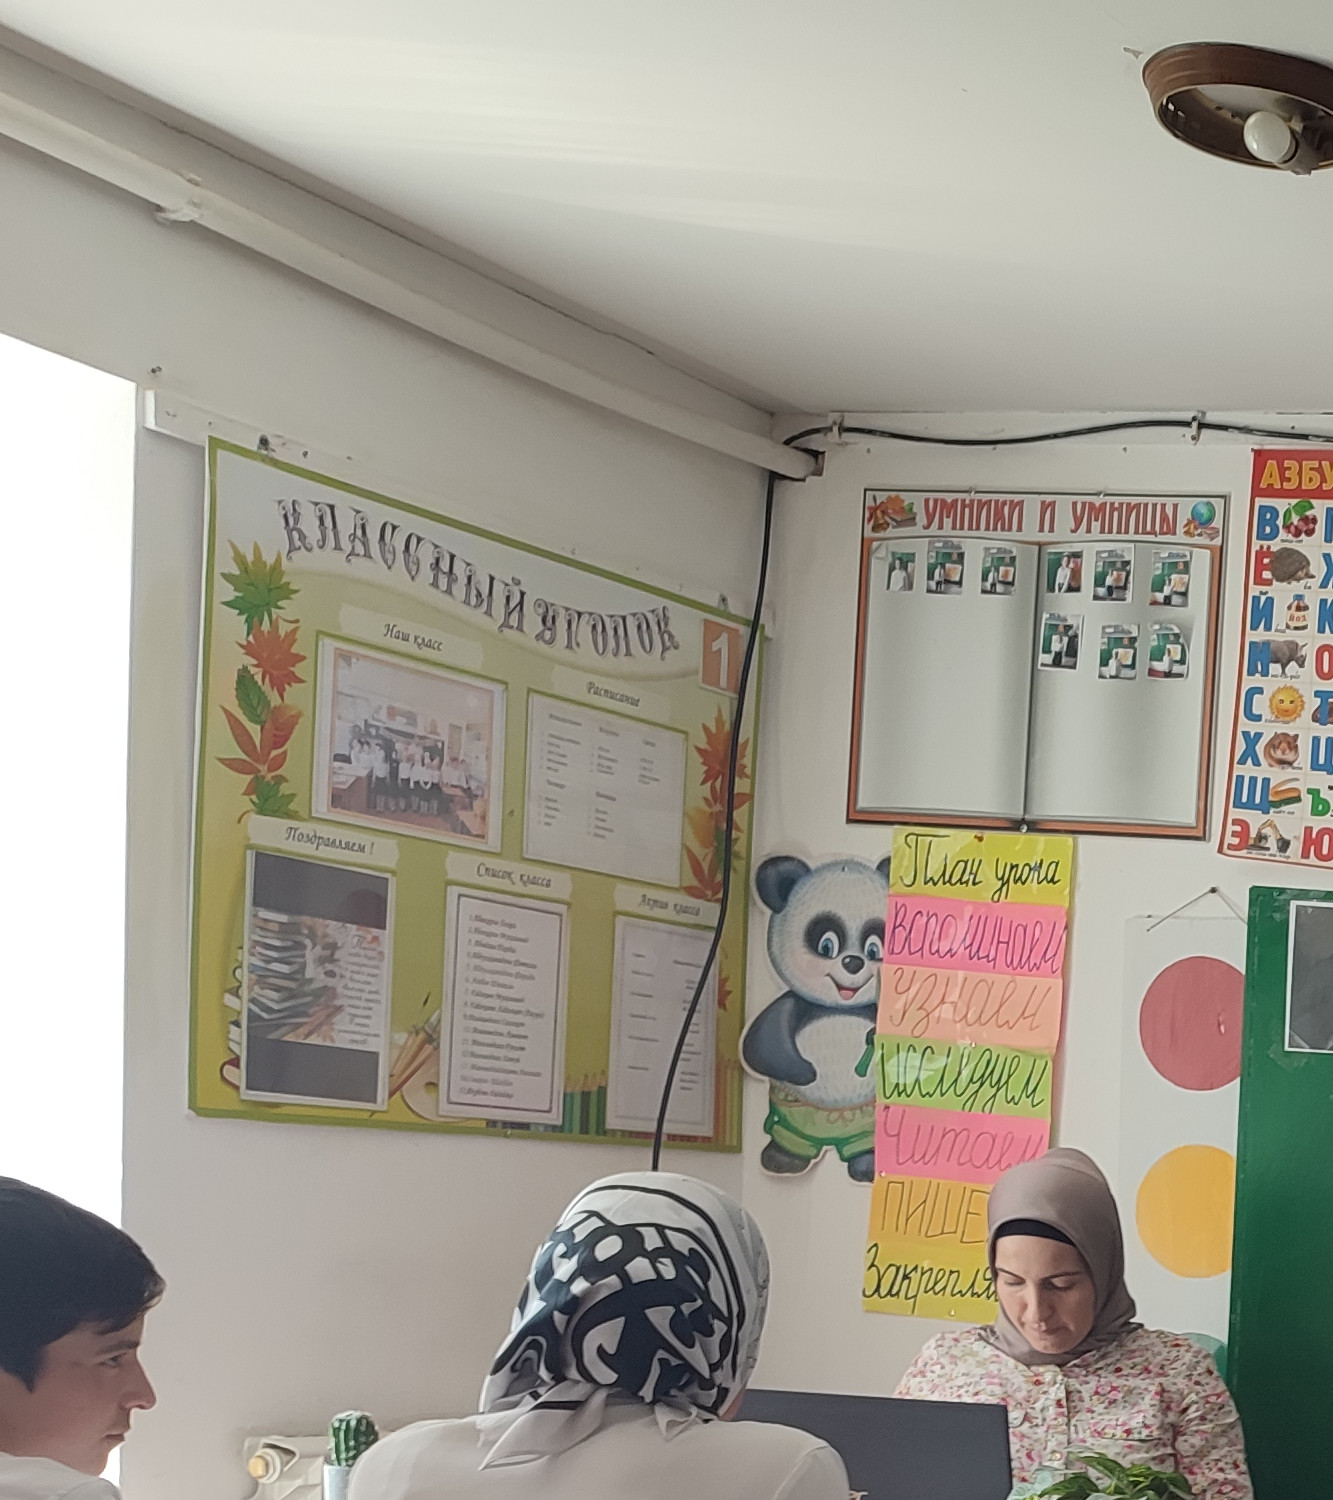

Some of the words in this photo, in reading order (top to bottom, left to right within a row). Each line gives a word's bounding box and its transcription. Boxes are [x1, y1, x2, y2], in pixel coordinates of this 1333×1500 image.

[922, 497, 1025, 533] УМНИКИ
[1038, 499, 1057, 534] И
[1069, 500, 1180, 538] УМНИЦЫ
[1256, 505, 1279, 541] В
[277, 498, 527, 634] КЛАССНЫЙ
[533, 597, 680, 661] УГОЛОК
[1251, 590, 1275, 632] Й
[383, 623, 411, 643] Наш
[413, 634, 444, 652] класс
[711, 630, 729, 689] 1
[1244, 686, 1264, 722] С
[1236, 730, 1264, 767] Х
[1233, 774, 1271, 815] Щ
[1306, 787, 1331, 817] Ъ
[285, 826, 367, 855] Поздравляем
[1227, 818, 1250, 851] Э
[476, 862, 515, 885] Список
[899, 832, 983, 888] План
[991, 854, 1062, 903] урока
